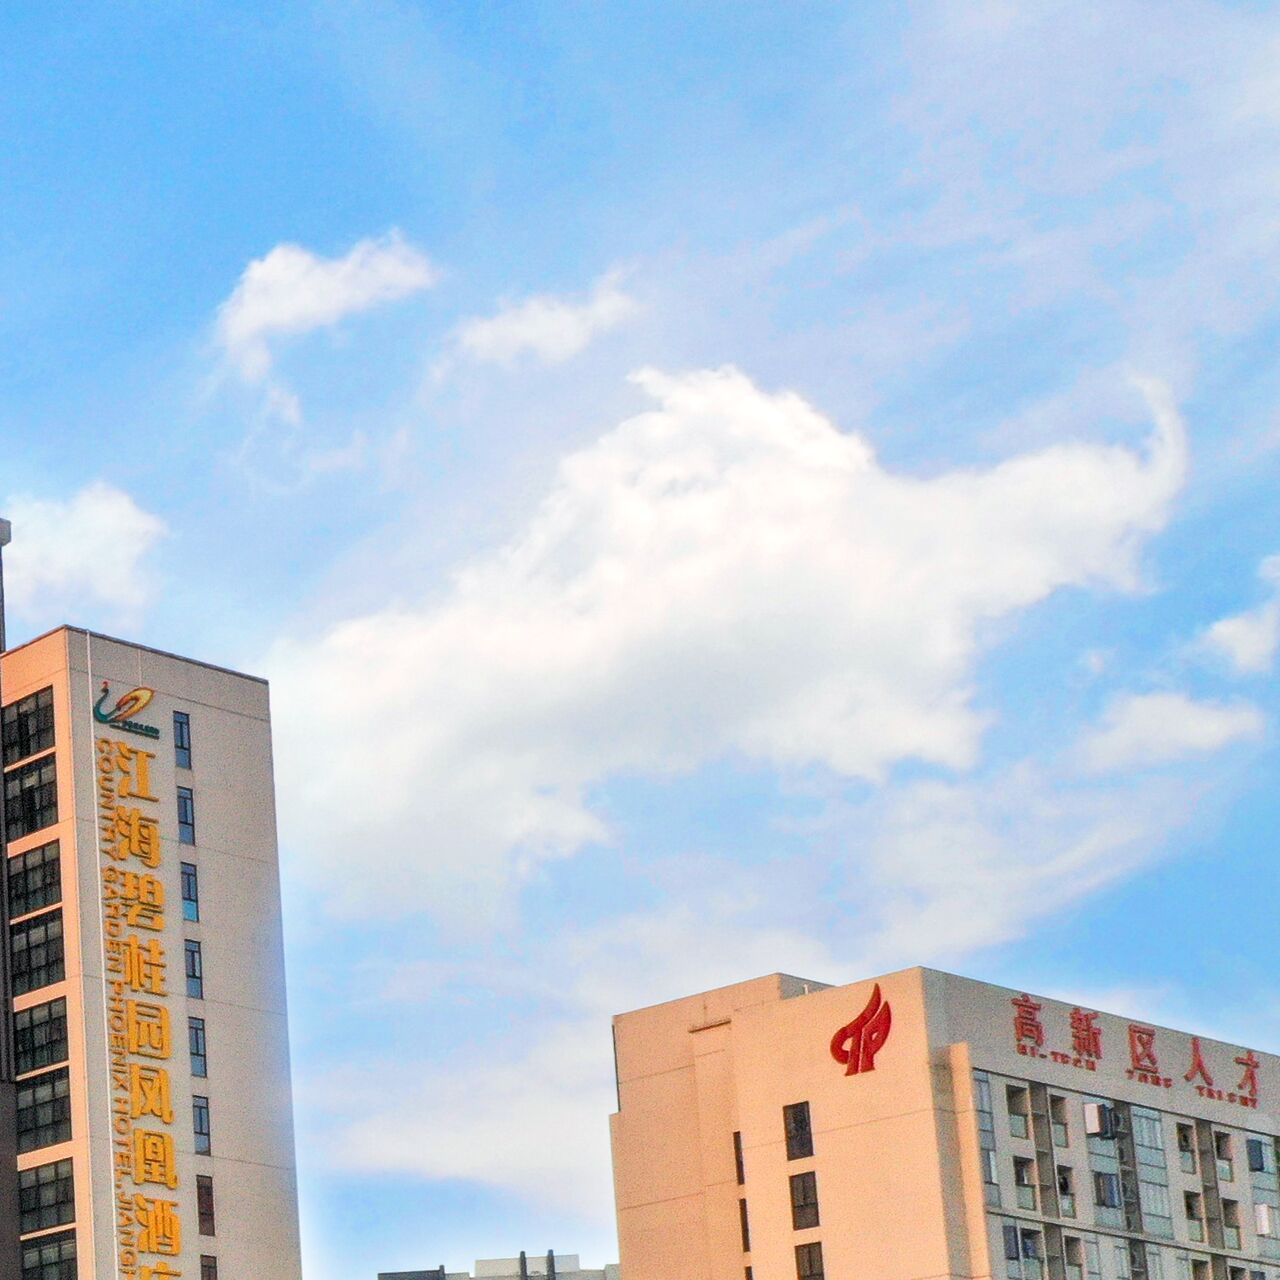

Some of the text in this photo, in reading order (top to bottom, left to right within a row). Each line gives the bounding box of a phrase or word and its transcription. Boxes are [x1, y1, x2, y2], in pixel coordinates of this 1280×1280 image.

[96, 737, 118, 861] COUNTRY
[102, 864, 124, 974] GARDEN
[106, 980, 129, 1091] PHOENIX
[1011, 993, 1260, 1097] 高新区人才
